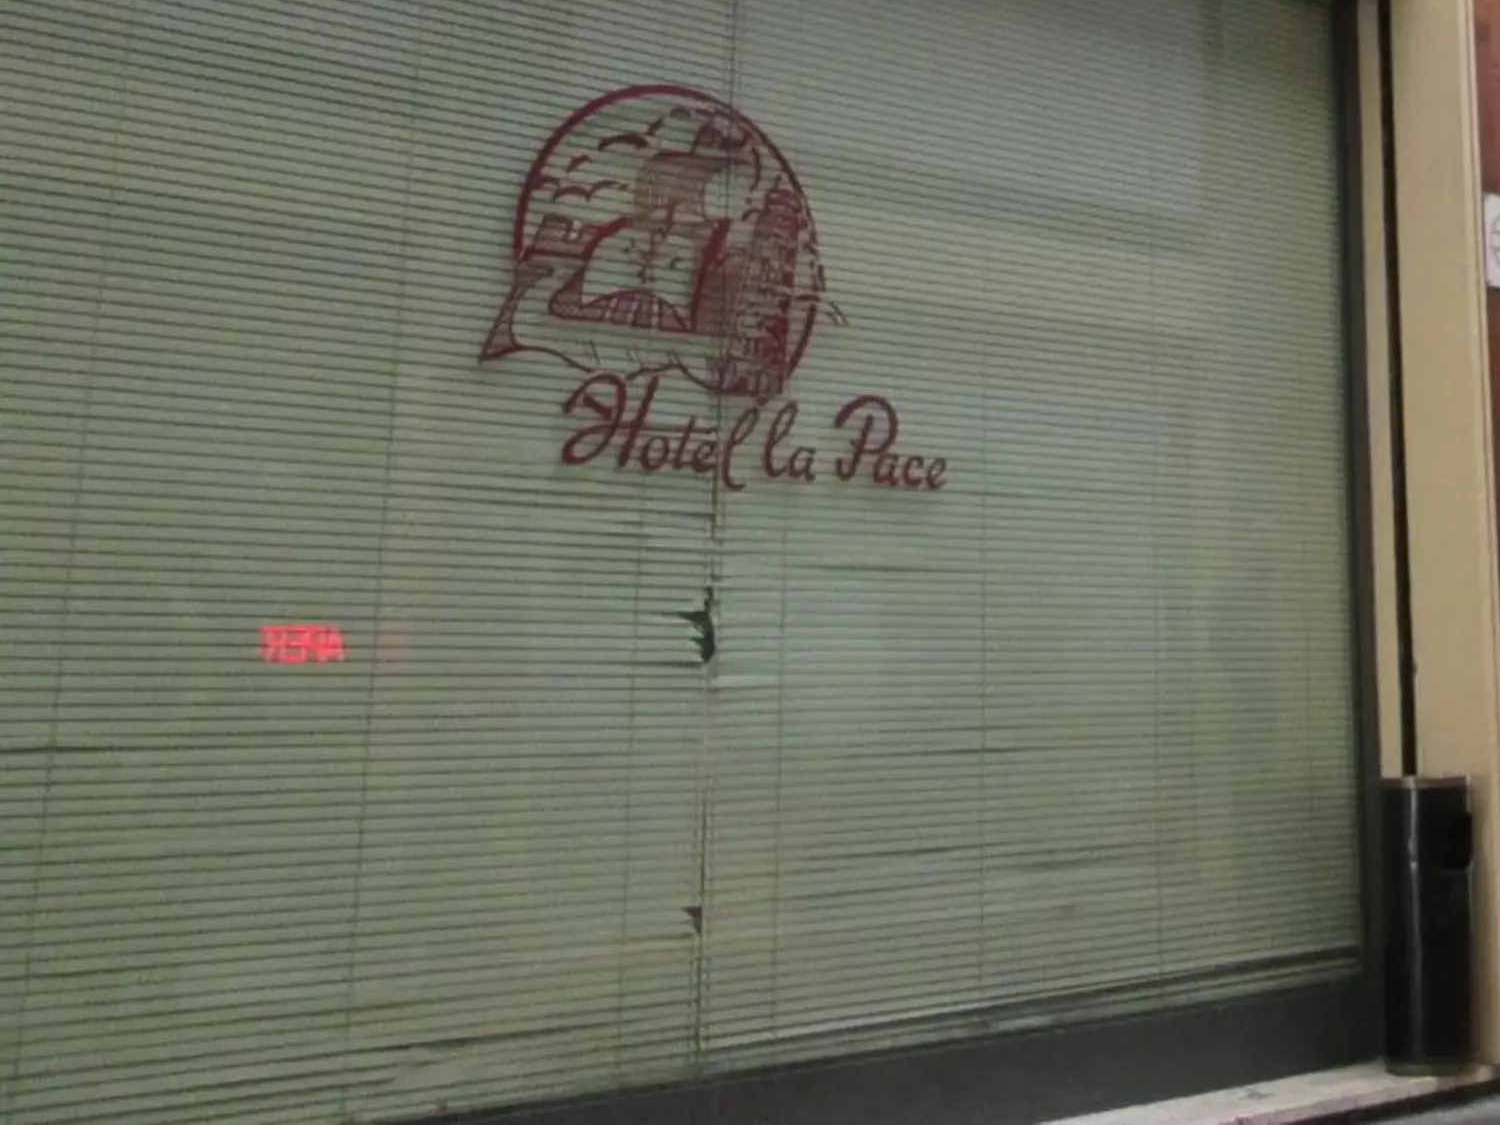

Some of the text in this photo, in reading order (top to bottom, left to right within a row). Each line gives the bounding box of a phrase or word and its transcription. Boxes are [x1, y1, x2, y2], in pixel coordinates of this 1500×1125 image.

[562, 373, 948, 491] Hotel la Pace
